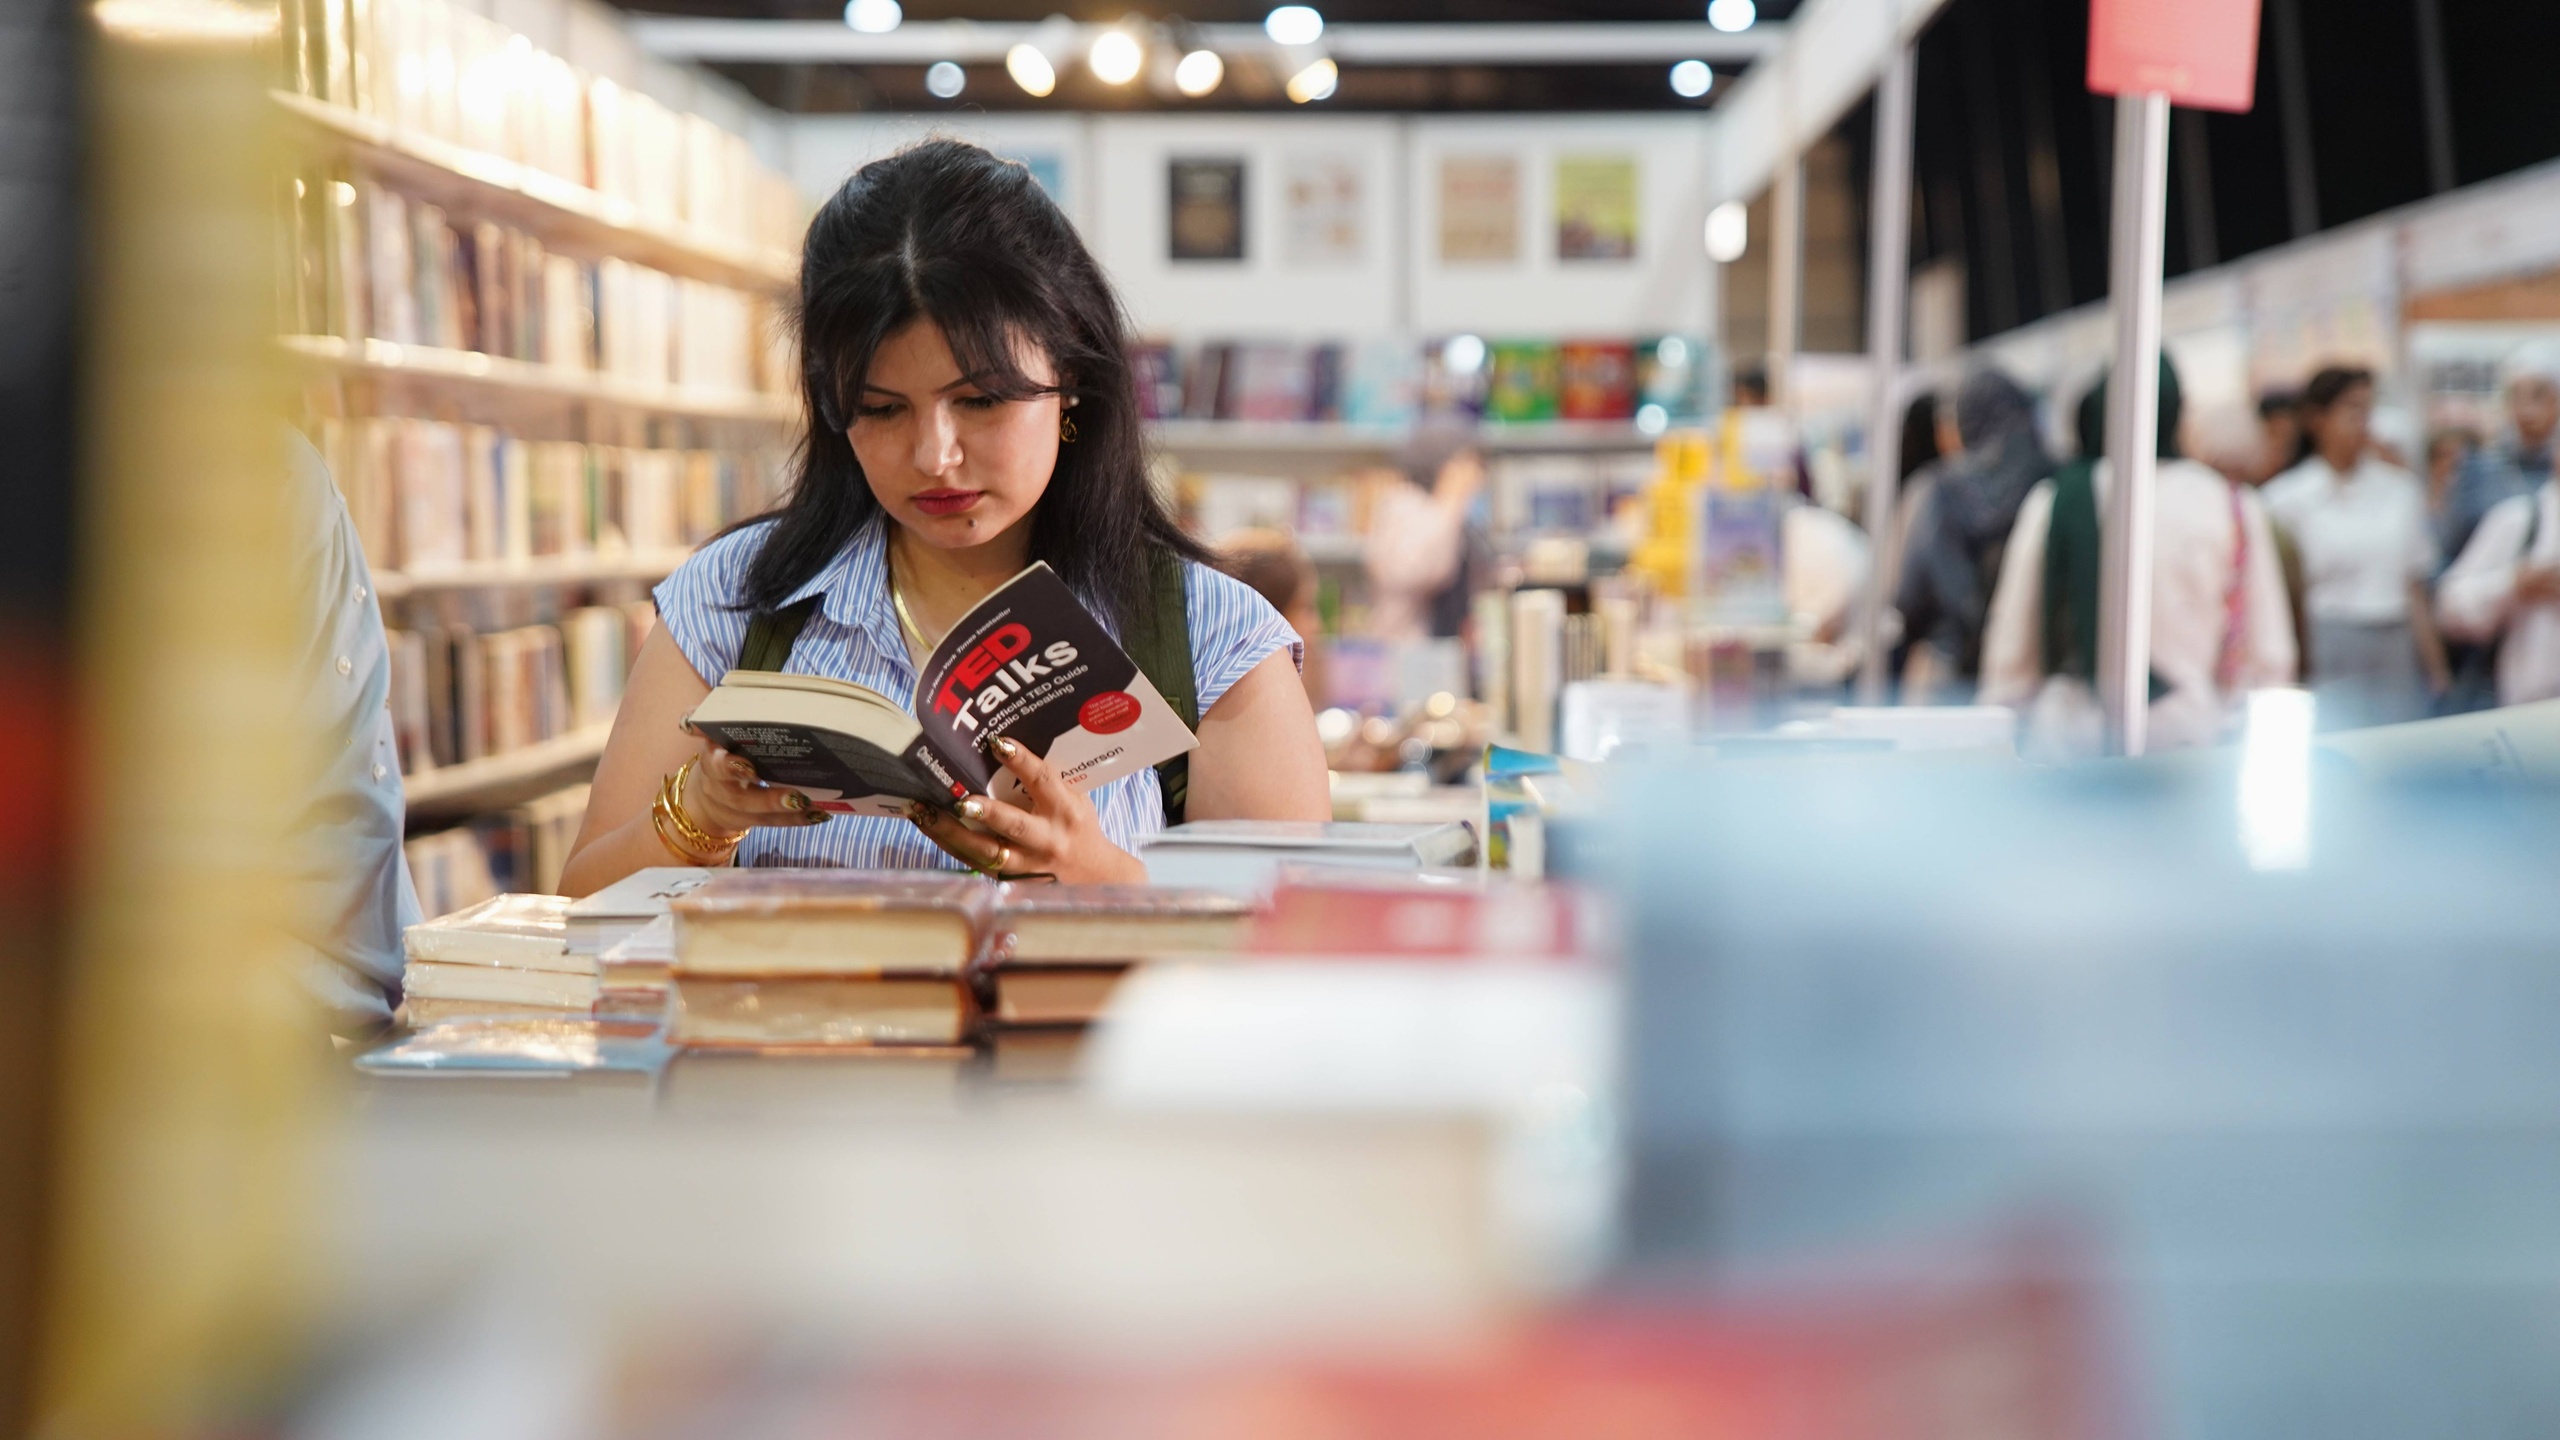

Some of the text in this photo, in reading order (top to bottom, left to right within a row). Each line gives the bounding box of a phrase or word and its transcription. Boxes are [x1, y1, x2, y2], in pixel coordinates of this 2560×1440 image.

[943, 655, 958, 670] York
[957, 634, 977, 653] Times
[977, 607, 1012, 636] bestseller
[933, 622, 1032, 715] TED
[952, 640, 1078, 732] Talks
[971, 664, 1089, 748] The Official TED Guide
[987, 714, 1020, 740] Public
[1020, 684, 1075, 716] Speaking
[916, 745, 934, 767] Chris
[1060, 745, 1125, 779] Anderson
[1066, 772, 1088, 785] TED
